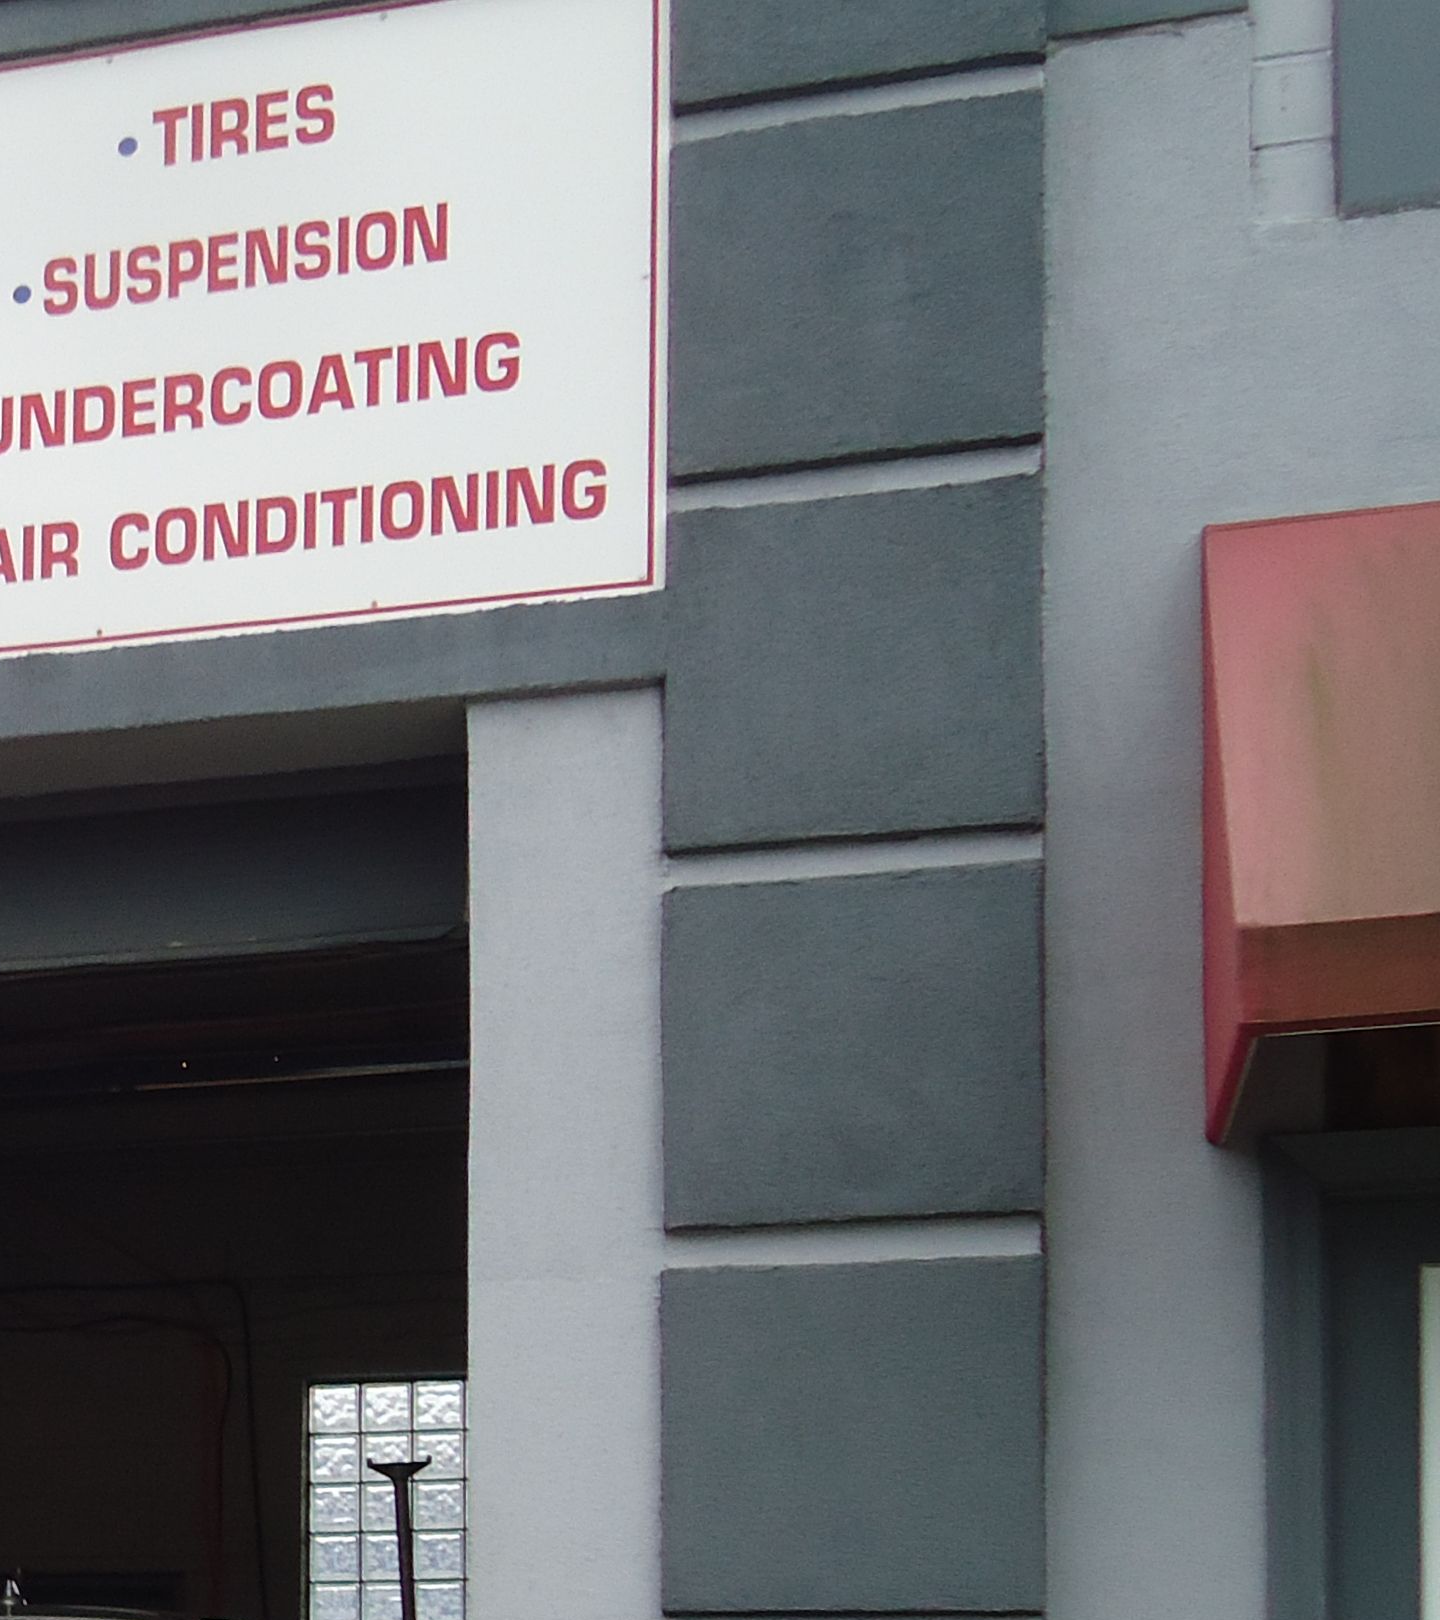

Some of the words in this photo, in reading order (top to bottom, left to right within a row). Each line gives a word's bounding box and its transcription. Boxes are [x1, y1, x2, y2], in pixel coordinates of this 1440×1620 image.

[152, 83, 337, 167] TIRES
[42, 201, 450, 316] SUSPENSION
[109, 459, 609, 572] CONDITIONING
